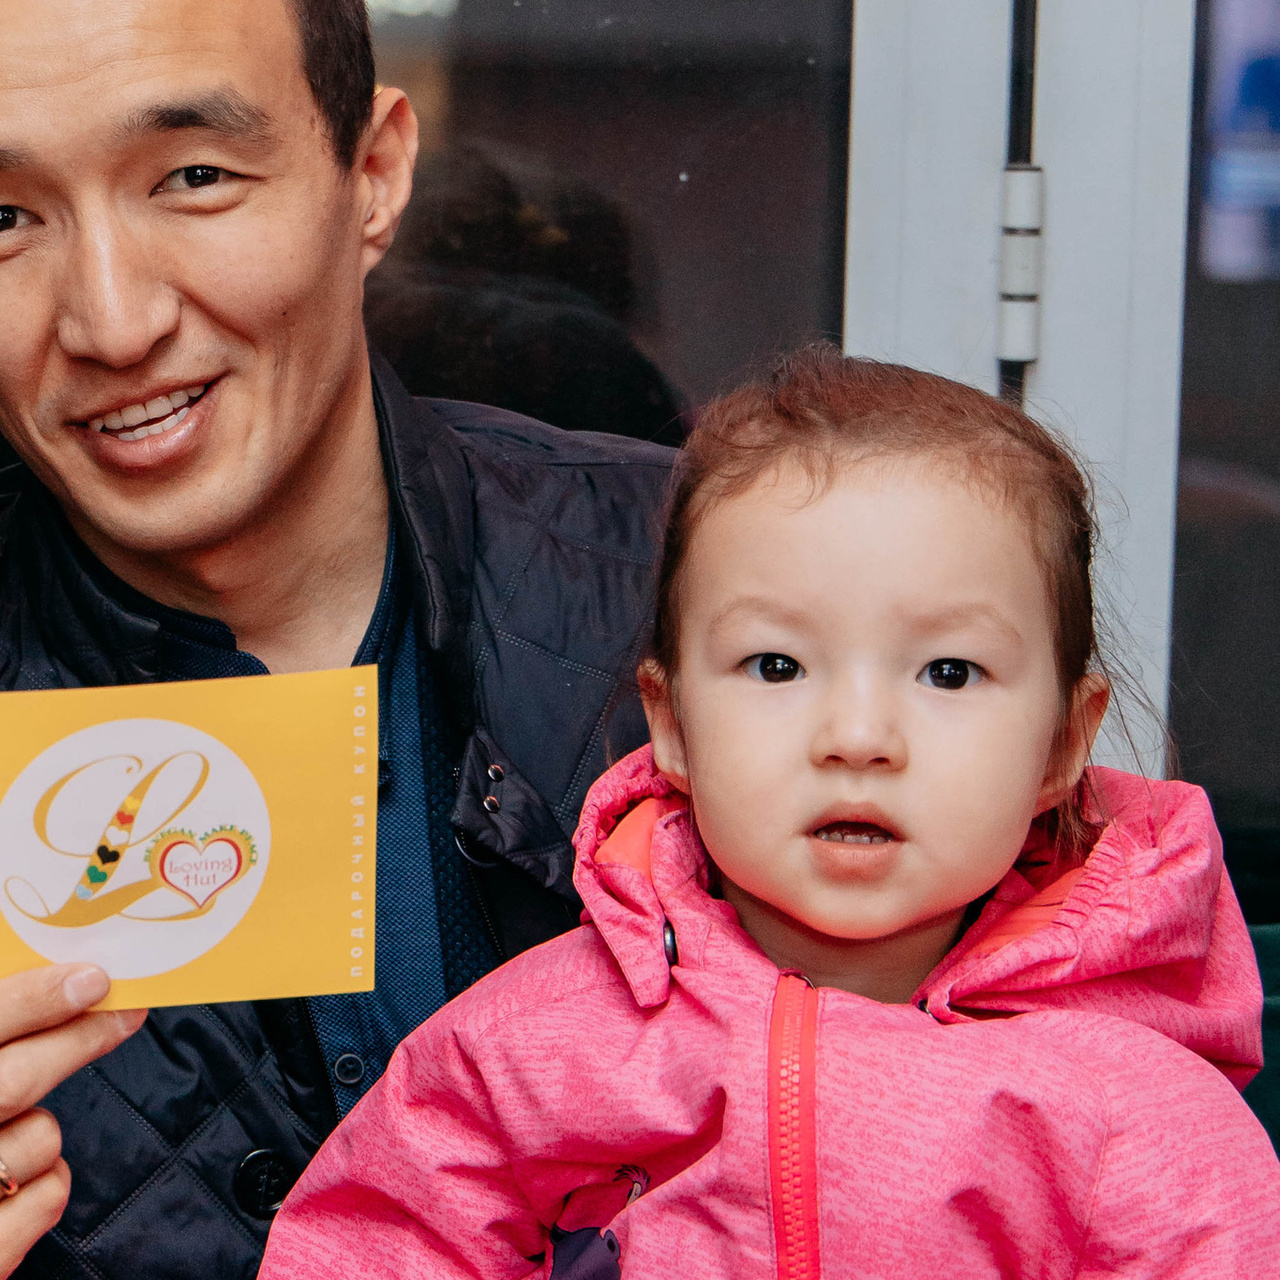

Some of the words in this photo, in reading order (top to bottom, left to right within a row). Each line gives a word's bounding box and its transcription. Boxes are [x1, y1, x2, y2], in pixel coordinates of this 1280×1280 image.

[353, 684, 367, 775] КУПОН
[168, 858, 233, 875] Loving
[183, 873, 218, 887] Hut
[350, 794, 366, 978] ПОДАРОЧНЫЙ
